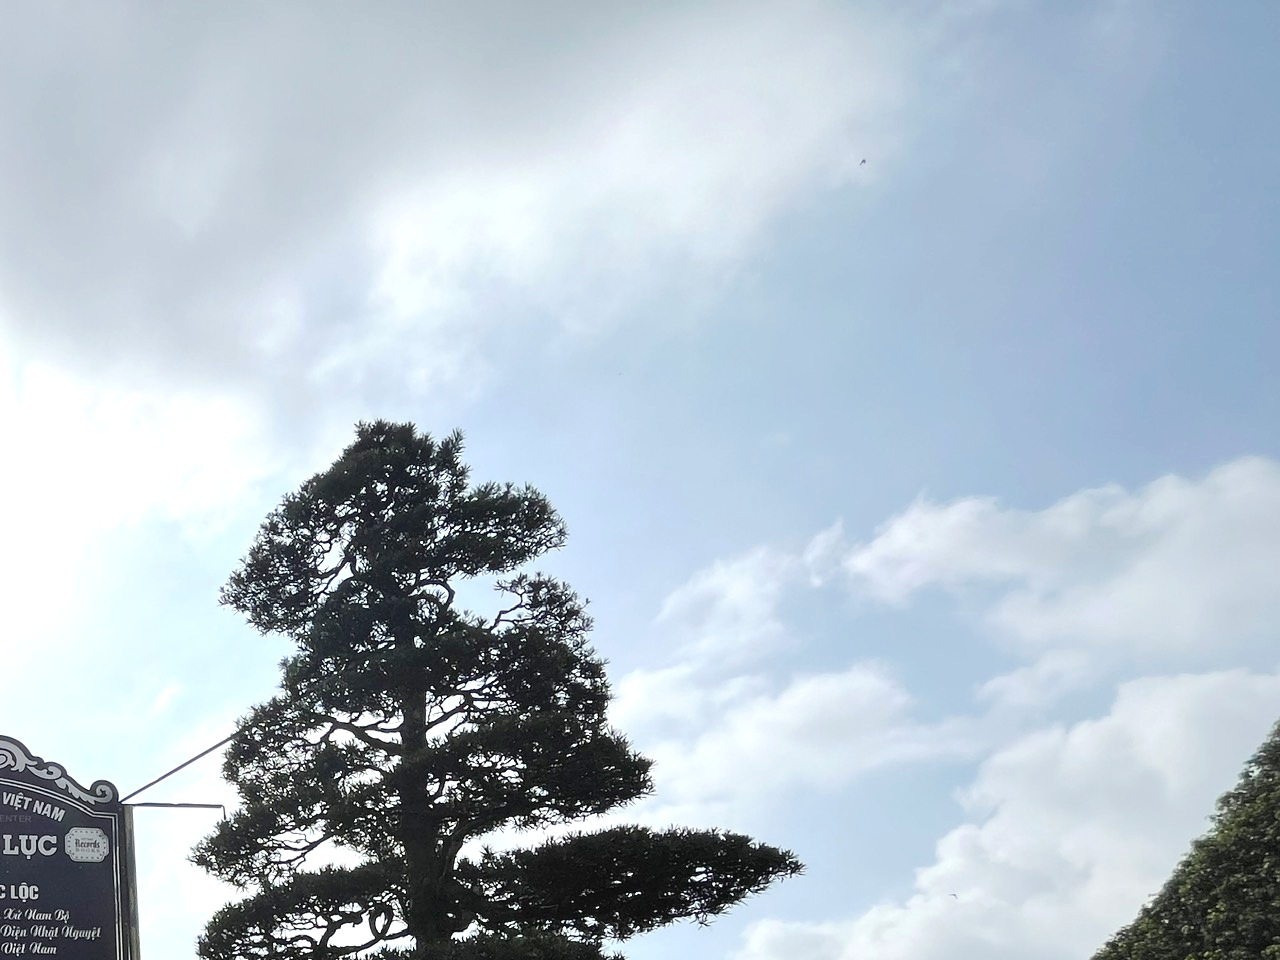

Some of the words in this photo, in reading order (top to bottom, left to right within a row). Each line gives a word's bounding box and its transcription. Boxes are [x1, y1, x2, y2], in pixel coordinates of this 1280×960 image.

[2, 792, 32, 811] VIỆT
[32, 800, 65, 822] NAM
[2, 834, 57, 860] LỤC
[74, 838, 100, 849] Records
[10, 882, 39, 903] LỘC
[24, 908, 52, 921] Nam
[54, 908, 70, 924] Bộ
[0, 924, 28, 940] Diện
[30, 924, 59, 941] Nhật
[61, 925, 101, 941] Nguyệt
[0, 941, 26, 957] Việt
[28, 942, 58, 955] Nam
